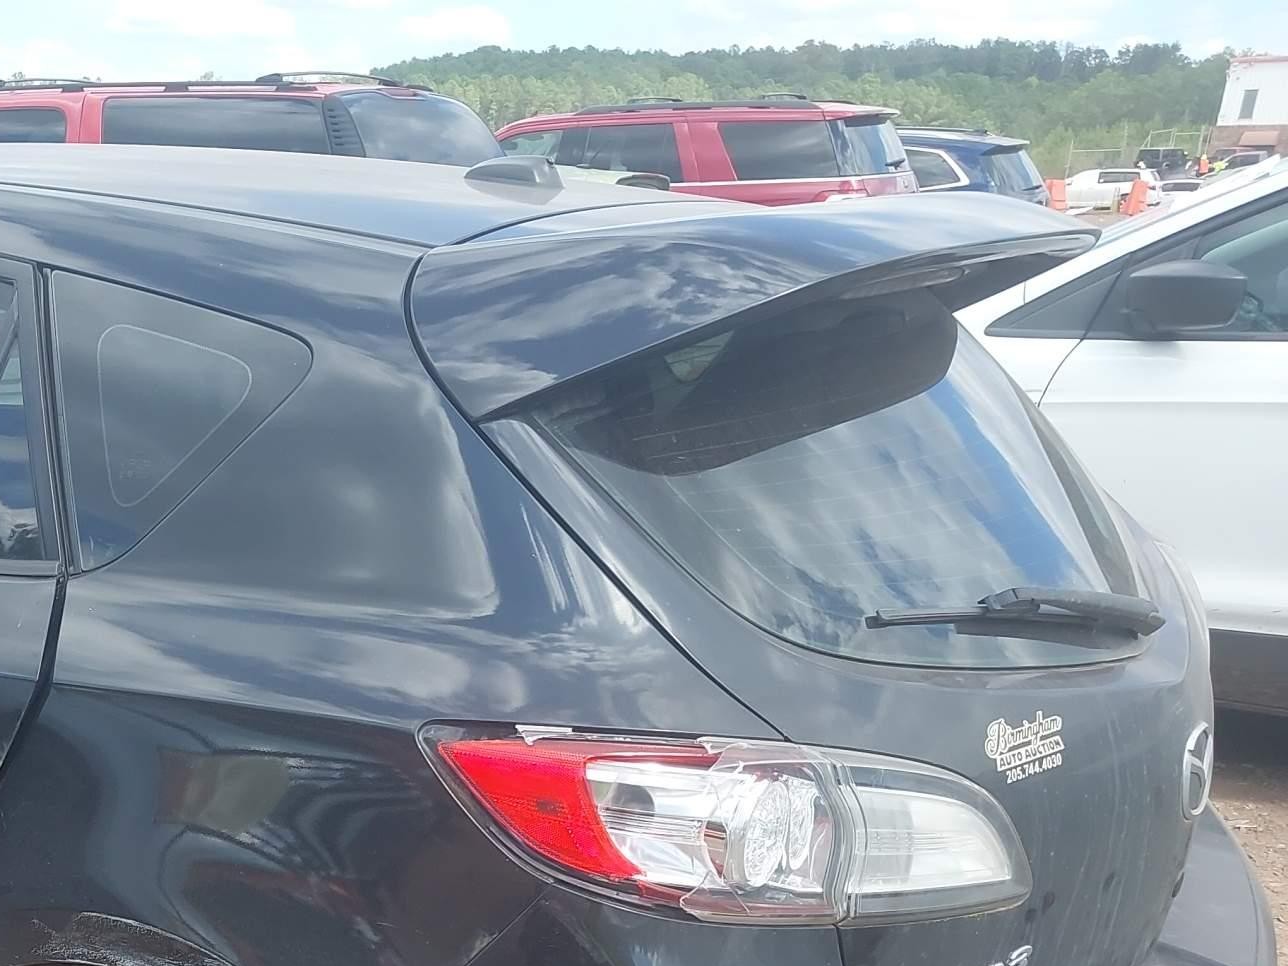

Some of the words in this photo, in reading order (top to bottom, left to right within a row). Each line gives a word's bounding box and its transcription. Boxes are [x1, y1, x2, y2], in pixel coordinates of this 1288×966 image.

[986, 711, 1062, 758] Birmingham
[998, 750, 1024, 770] AUTO
[1025, 737, 1061, 760] AUCTION
[1006, 753, 1062, 784] 205.744.4030
